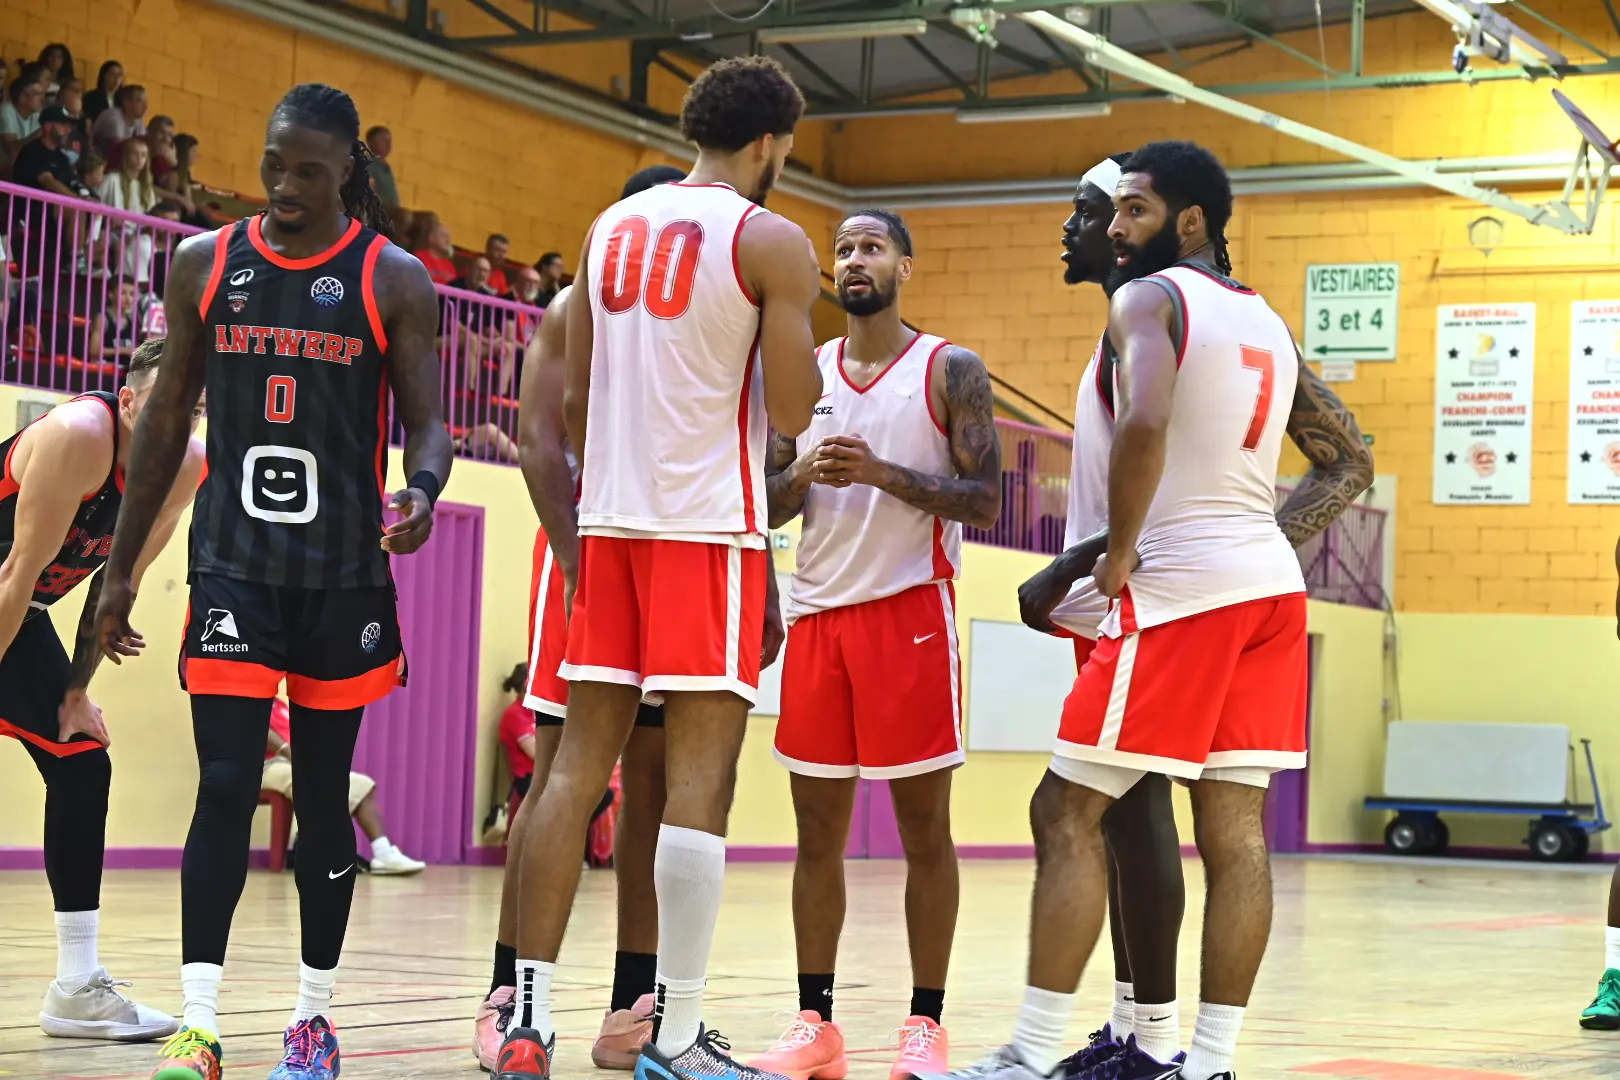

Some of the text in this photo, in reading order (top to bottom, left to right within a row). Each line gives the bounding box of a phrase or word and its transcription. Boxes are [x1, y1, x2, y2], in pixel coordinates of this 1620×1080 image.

[600, 215, 705, 320] 00
[1311, 268, 1395, 292] VESTIAIRES
[1318, 308, 1383, 331] 3 et 4
[215, 325, 363, 365] ANTWERP
[265, 375, 296, 423] 0
[1240, 344, 1274, 452] 7
[1457, 392, 1513, 401] CHAMPION
[201, 643, 249, 653] aertssen
